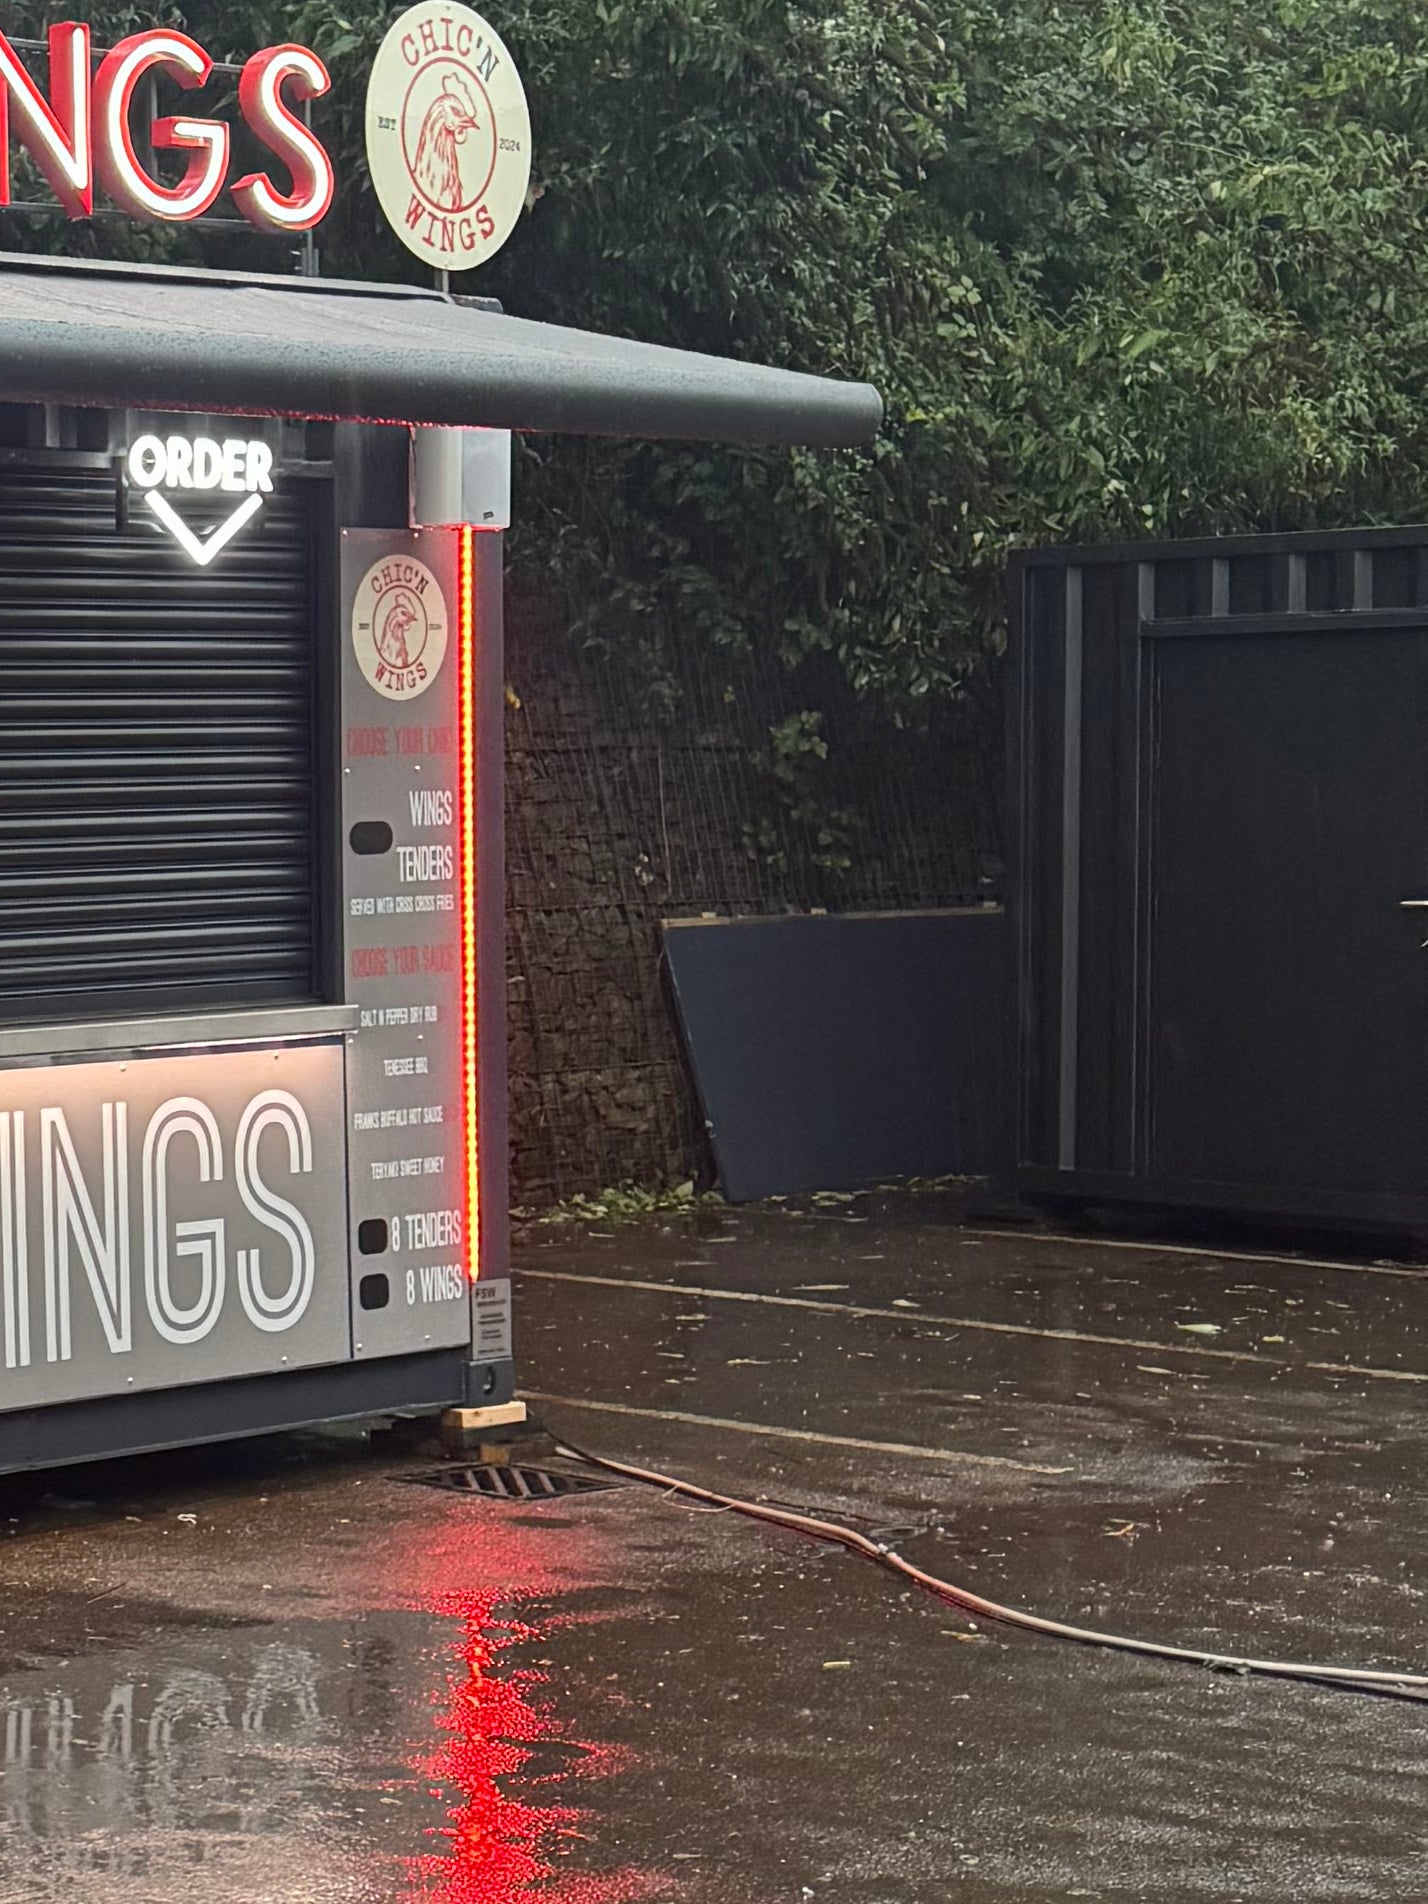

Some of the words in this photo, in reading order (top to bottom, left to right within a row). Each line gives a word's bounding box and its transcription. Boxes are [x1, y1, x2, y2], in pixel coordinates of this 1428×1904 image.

[401, 17, 499, 83] CHIC'N
[378, 116, 396, 131] EST
[405, 193, 495, 252] WINGS
[128, 435, 273, 492] ORDER
[375, 661, 427, 691] WINGS
[409, 790, 453, 826] WINGS
[396, 845, 453, 882] TENDERS
[391, 1216, 401, 1252] 8
[405, 1209, 462, 1251] TENDERS
[406, 1269, 416, 1305] 8
[420, 1263, 463, 1304] WINGS
